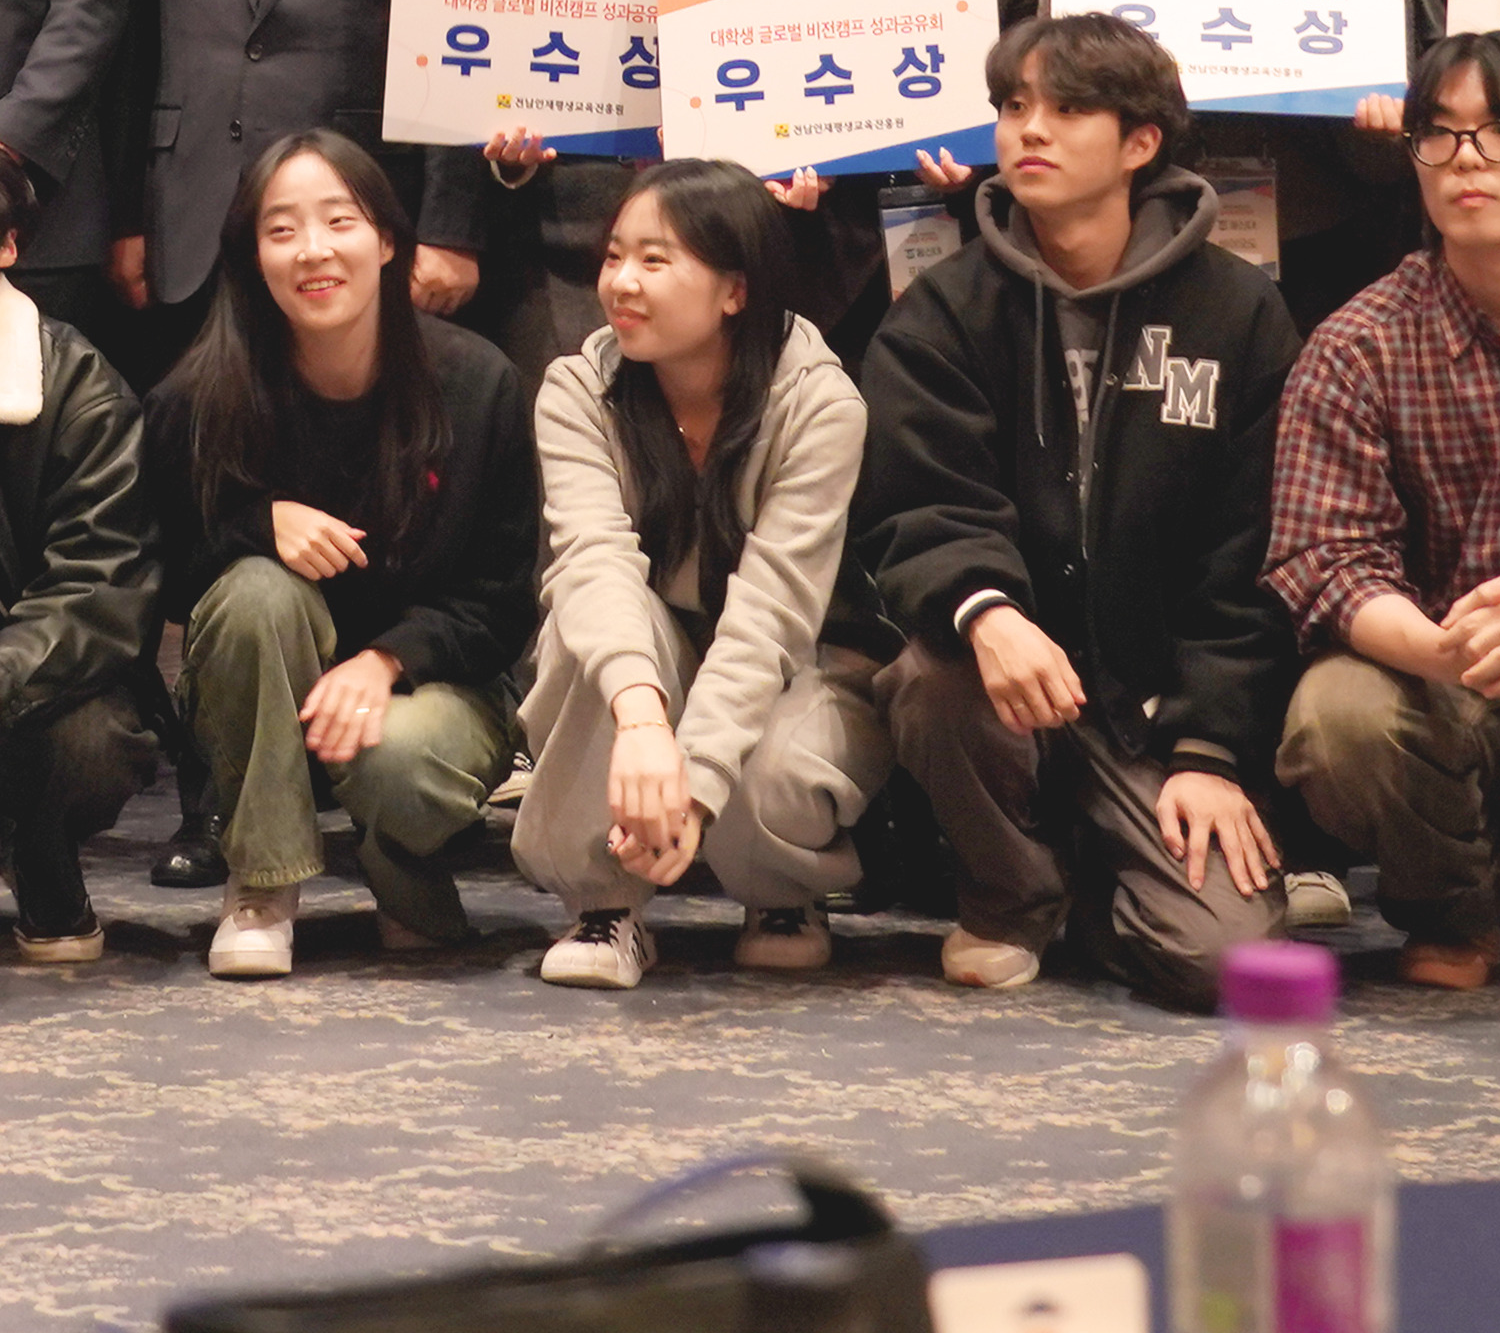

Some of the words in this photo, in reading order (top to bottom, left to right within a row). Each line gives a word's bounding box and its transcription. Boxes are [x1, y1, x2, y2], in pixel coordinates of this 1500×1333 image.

[603, 3, 658, 24] 성과공유
[711, 27, 753, 47] 대학생
[759, 23, 802, 44] 글로벌
[807, 20, 865, 39] 비전캠프
[870, 12, 943, 36] 성과공유회
